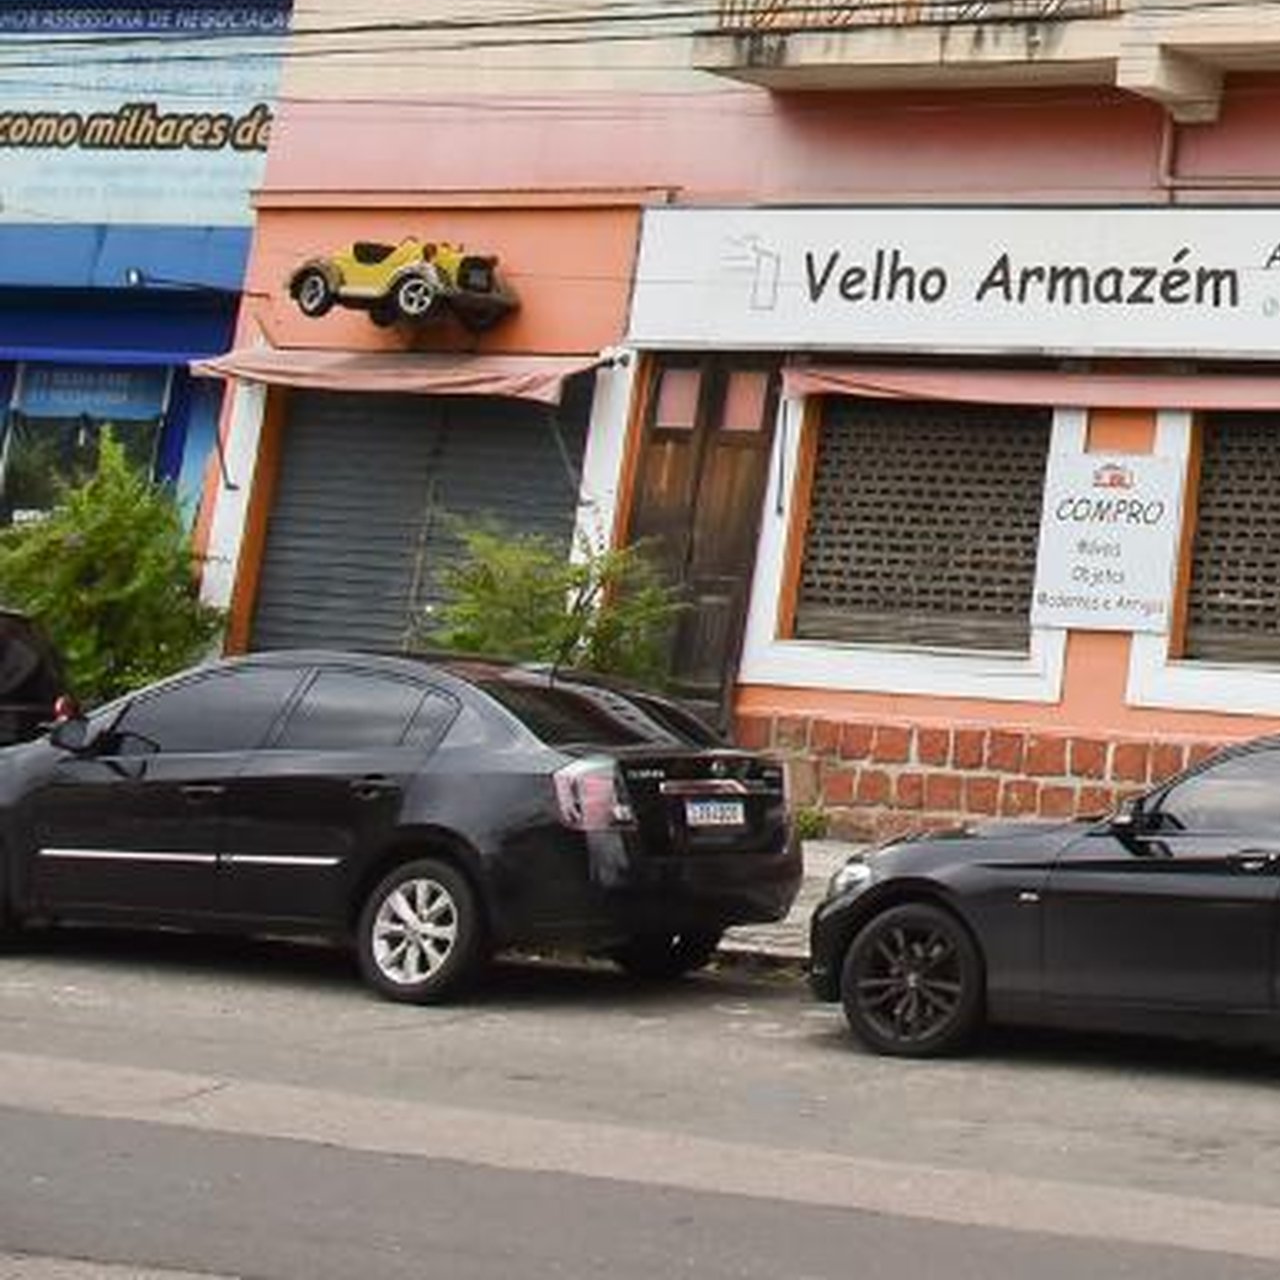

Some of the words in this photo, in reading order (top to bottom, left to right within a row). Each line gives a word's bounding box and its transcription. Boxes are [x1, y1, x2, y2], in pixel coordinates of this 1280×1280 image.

[83, 106, 228, 146] milhares
[804, 249, 949, 303] Velho
[975, 247, 1239, 307] Armazém
[1056, 498, 1165, 524] COMPRO
